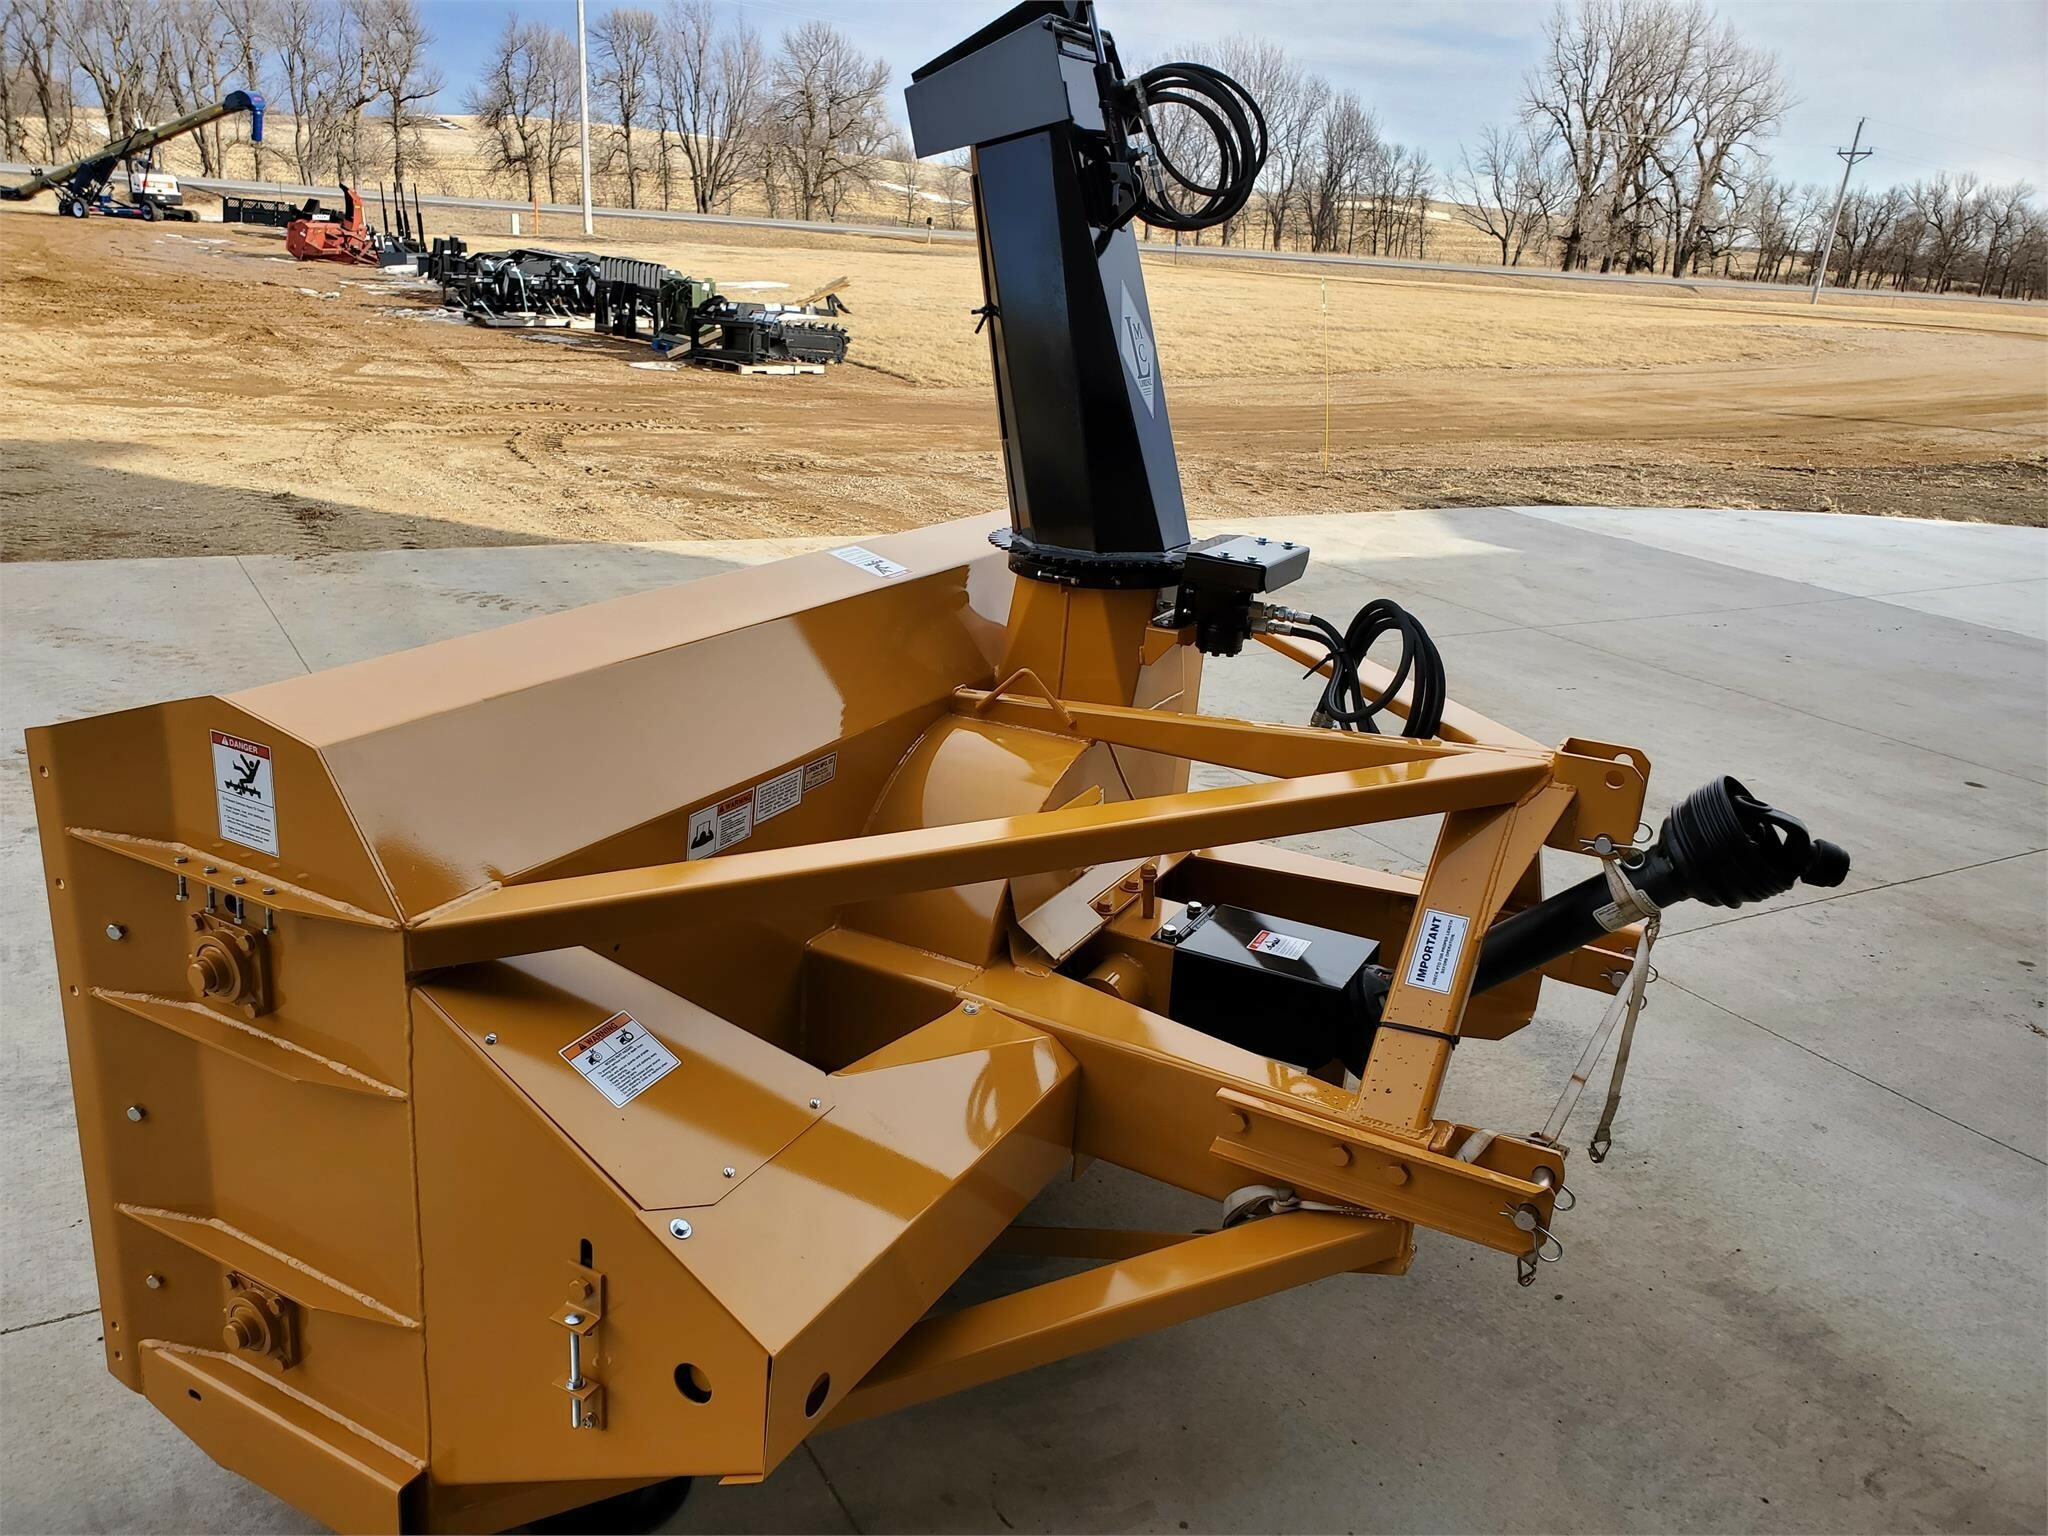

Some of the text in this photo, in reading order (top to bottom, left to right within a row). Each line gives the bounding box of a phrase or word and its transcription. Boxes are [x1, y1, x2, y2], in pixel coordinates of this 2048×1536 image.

[228, 738, 258, 754] DANGER
[724, 794, 752, 812] WARNING
[1416, 916, 1442, 982] IMPORTANT
[584, 1022, 618, 1046] WARNING
